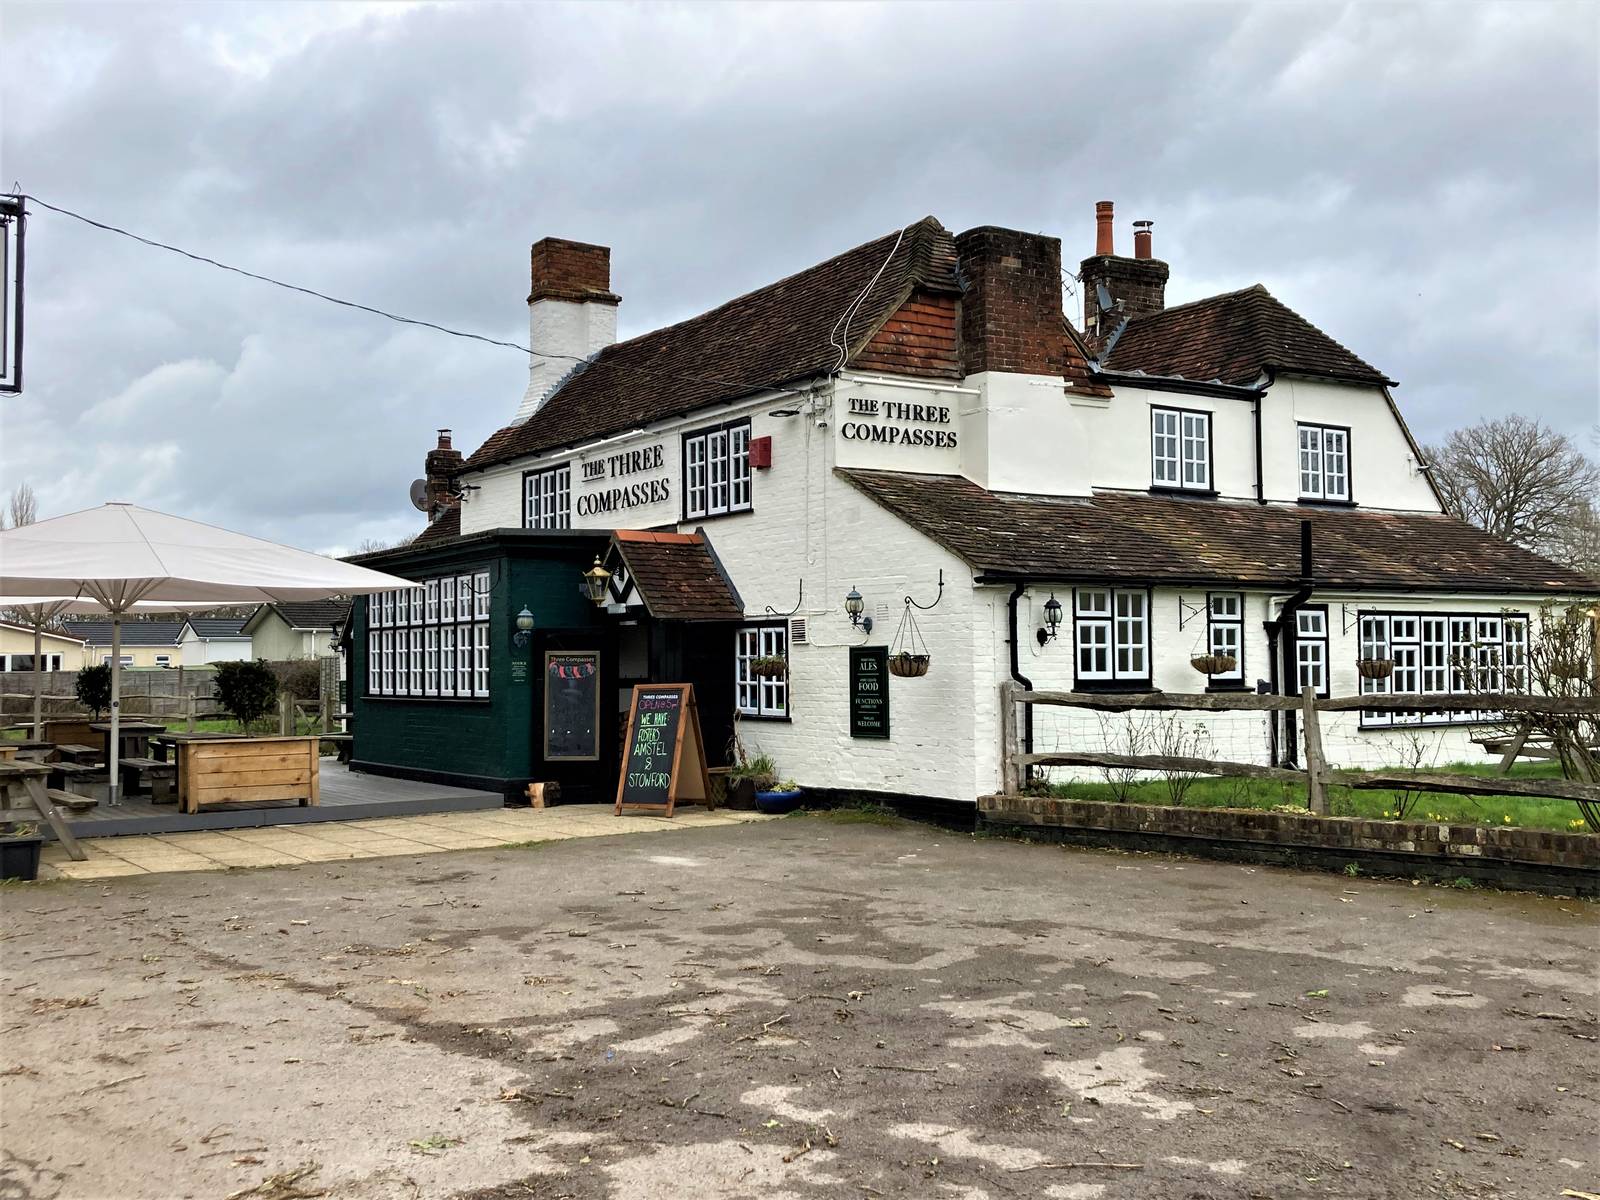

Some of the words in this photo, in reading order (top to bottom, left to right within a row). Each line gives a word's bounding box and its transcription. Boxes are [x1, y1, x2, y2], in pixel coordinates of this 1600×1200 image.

[848, 398, 879, 415] THE
[882, 401, 951, 424] THREE
[841, 422, 957, 448] COMPASSES
[581, 459, 605, 480] THE
[607, 444, 664, 478] THREE
[577, 477, 670, 516] COMPASSES
[860, 662, 877, 670] ALES
[859, 682, 878, 691] FOOD
[641, 712, 652, 725] WE
[634, 742, 667, 756] AMSTEL
[645, 757, 652, 770] &
[629, 773, 671, 789] STOWFORD
